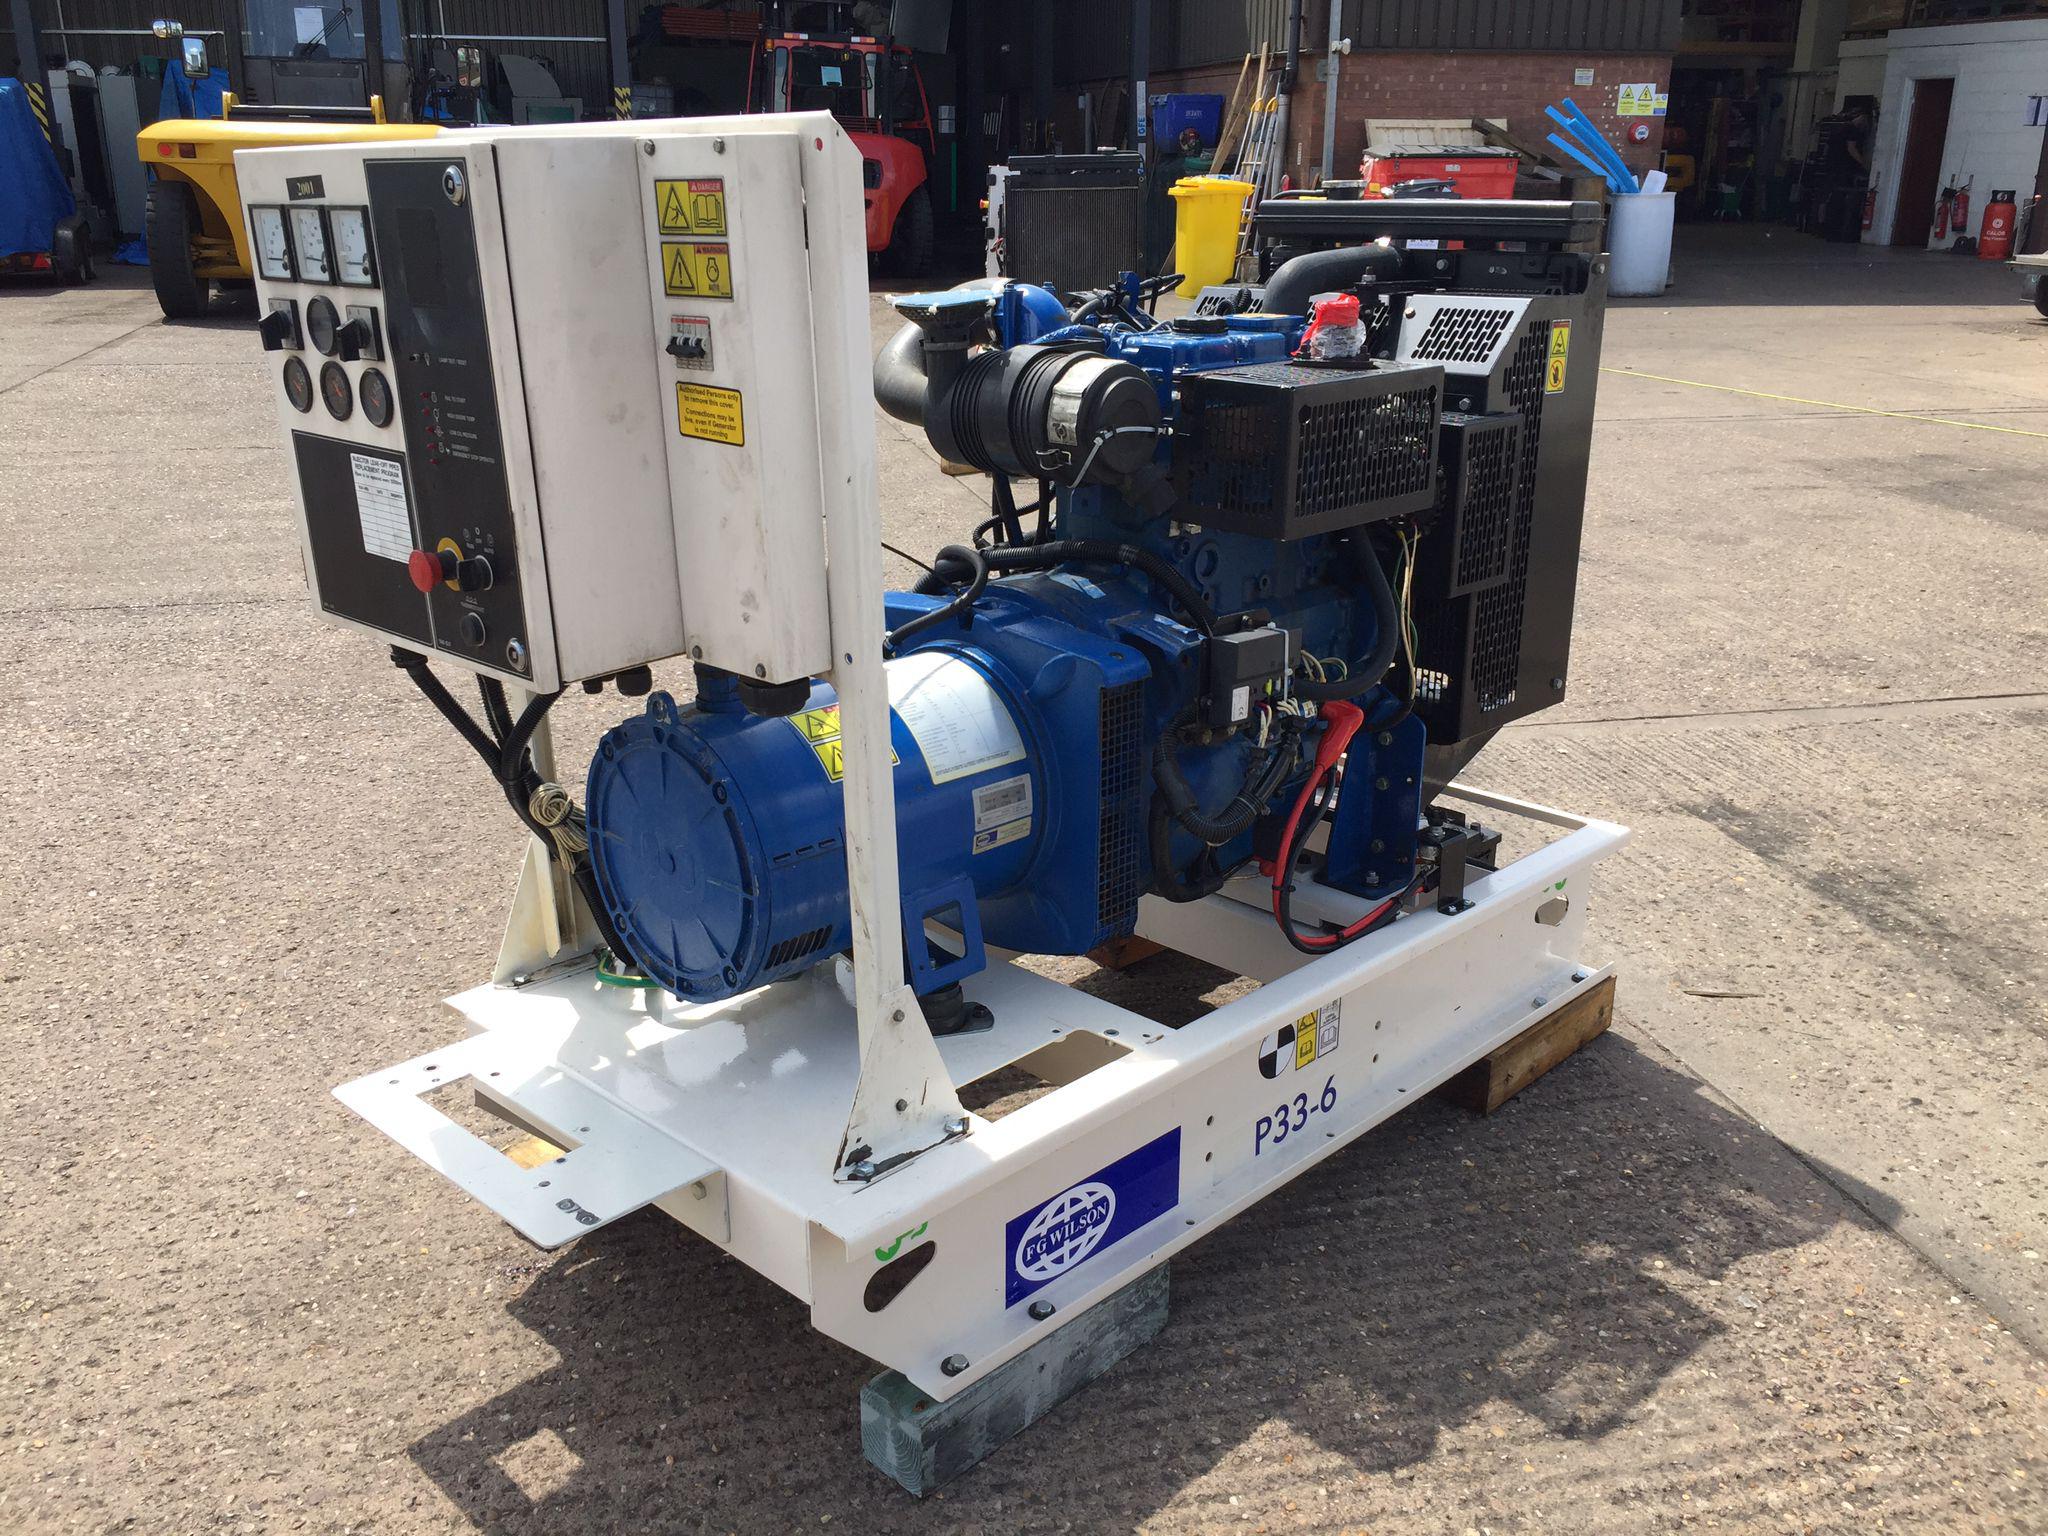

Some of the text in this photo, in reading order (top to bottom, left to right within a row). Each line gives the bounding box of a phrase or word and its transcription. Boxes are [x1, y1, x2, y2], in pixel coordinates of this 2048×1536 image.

[697, 182, 721, 191] DANGER
[680, 385, 739, 403] Authorised Persons only
[690, 397, 708, 405] remove
[709, 399, 719, 407] this
[686, 408, 716, 419] Connections
[717, 414, 727, 422] may
[713, 421, 737, 431] Generator
[709, 430, 728, 440] running
[1255, 1074, 1337, 1157] P33-6
[1025, 1201, 1110, 1262] FG WILSON
